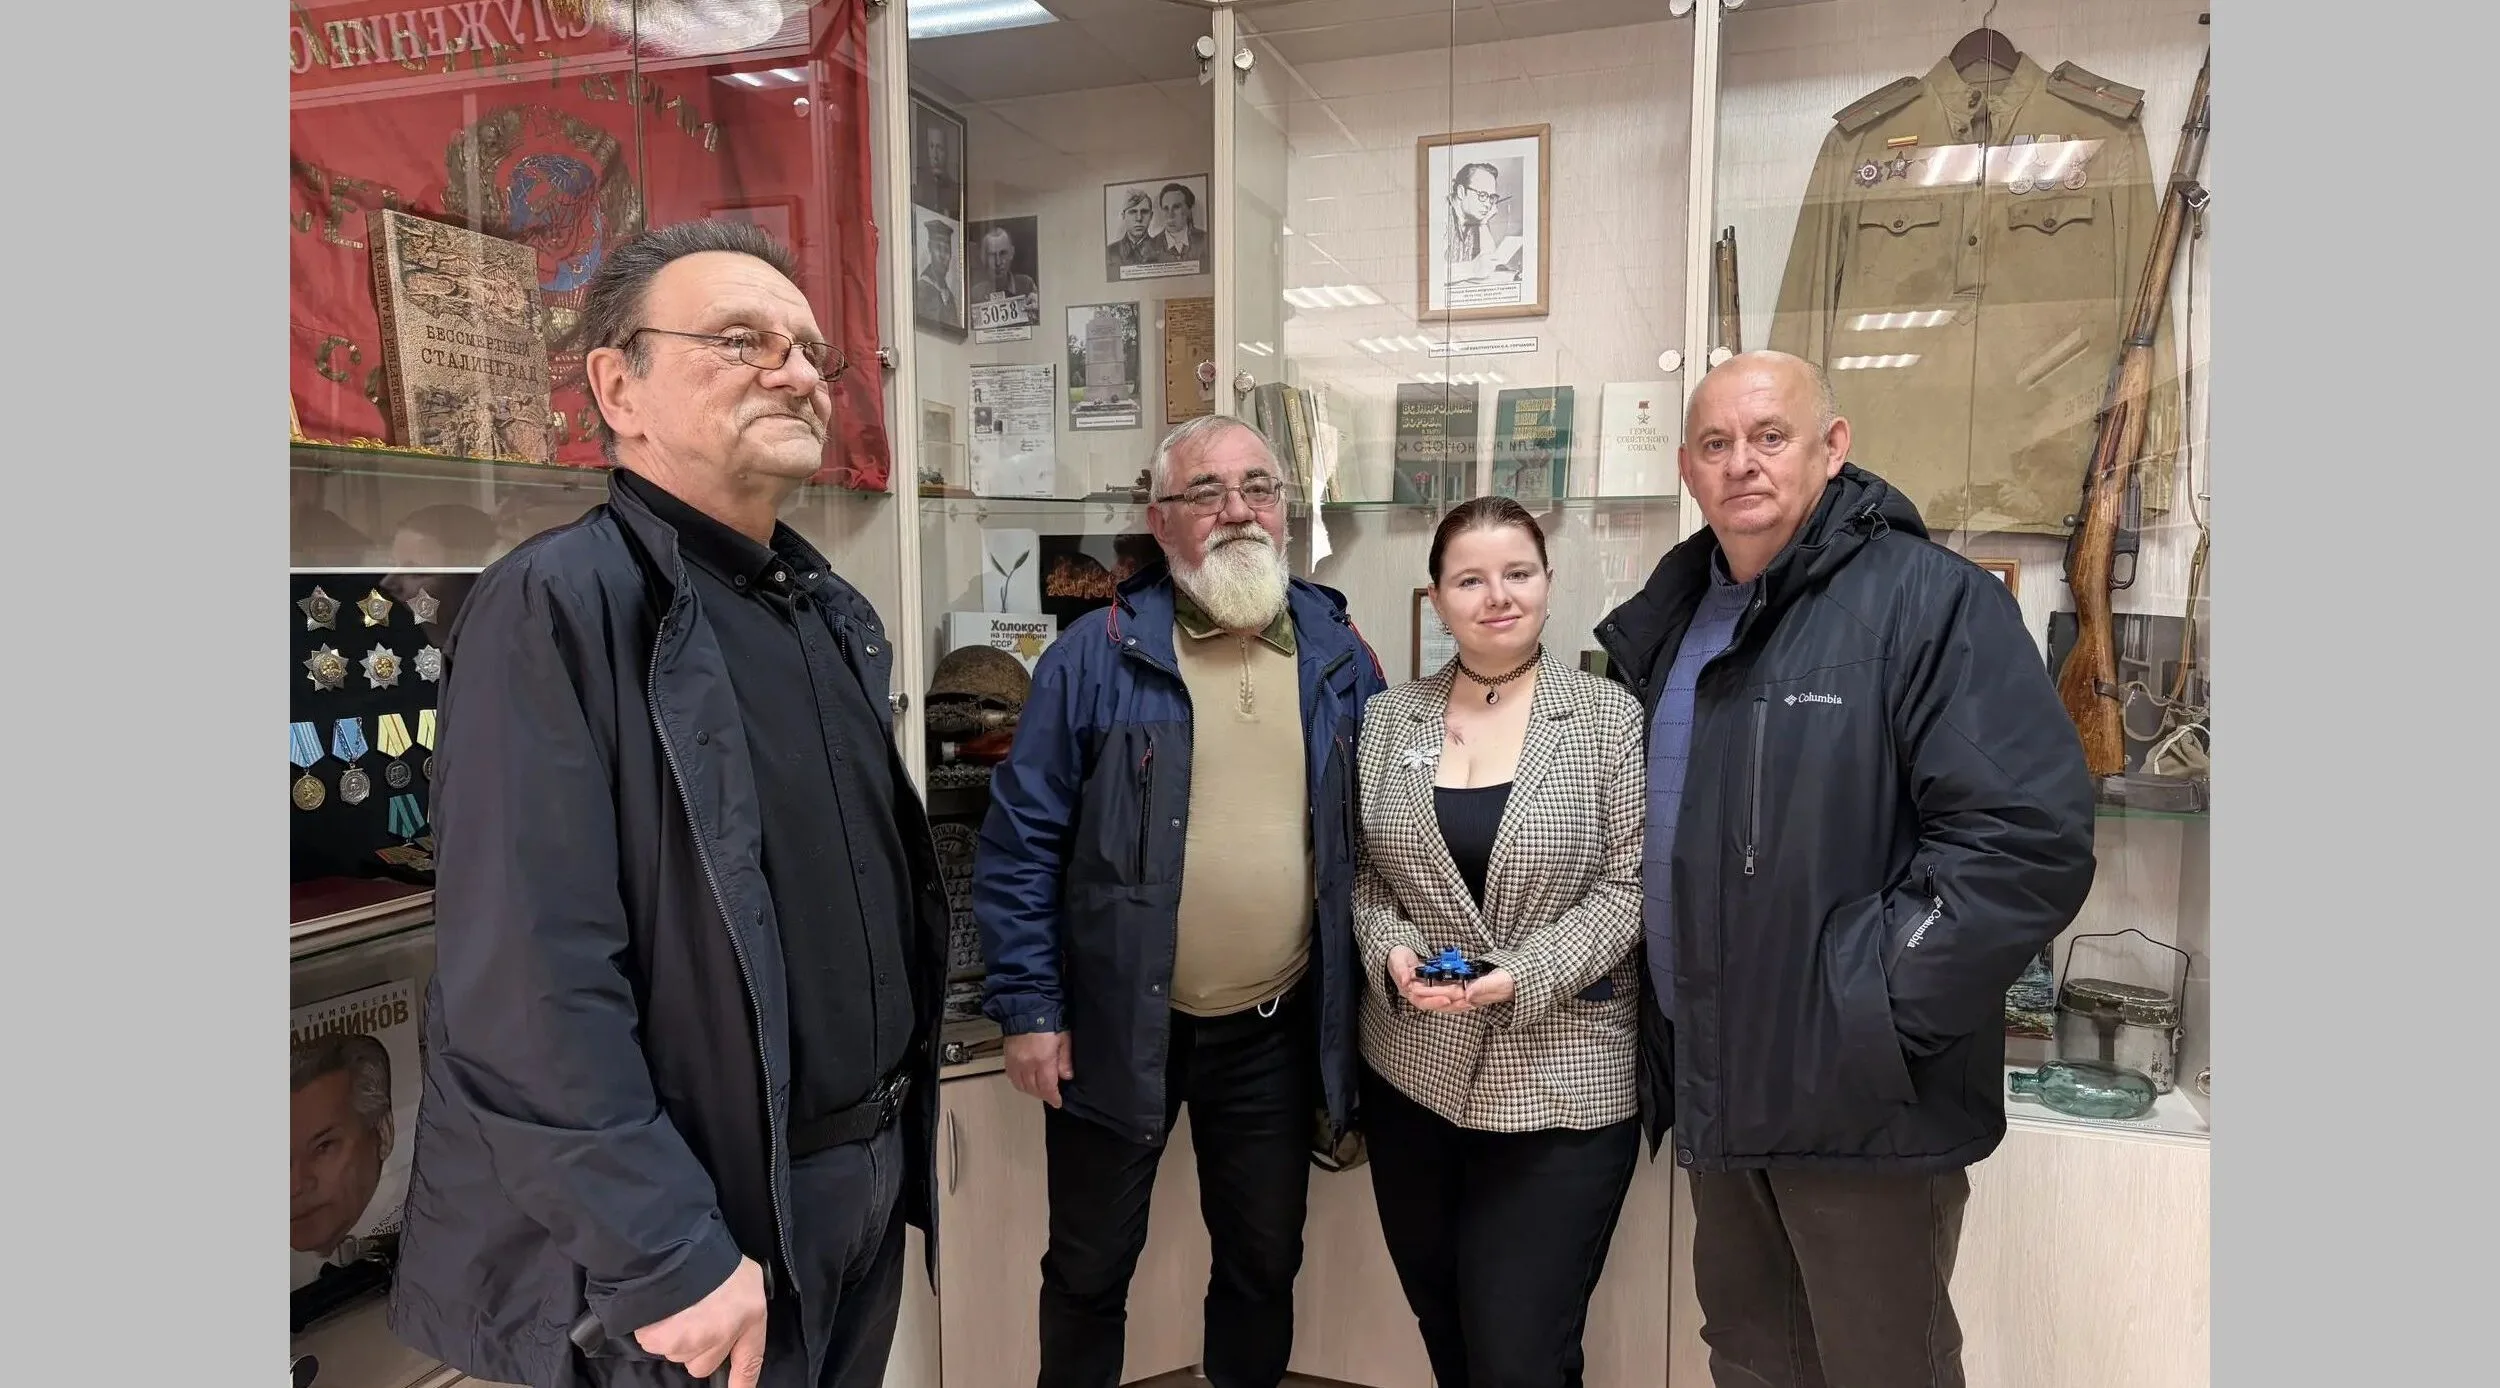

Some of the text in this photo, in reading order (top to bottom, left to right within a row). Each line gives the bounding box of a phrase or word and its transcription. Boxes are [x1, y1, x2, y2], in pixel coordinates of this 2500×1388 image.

[981, 301, 1018, 324] 3058
[425, 325, 531, 357] БЕССМЕРТНЫЙ
[421, 347, 539, 382] СТАЛИНГРАД
[991, 620, 1048, 632] Холокост
[1799, 692, 1842, 704] Columbia
[1907, 909, 1941, 947] Columbia
[308, 988, 408, 1022] ТИМОФЕЕВИЧ
